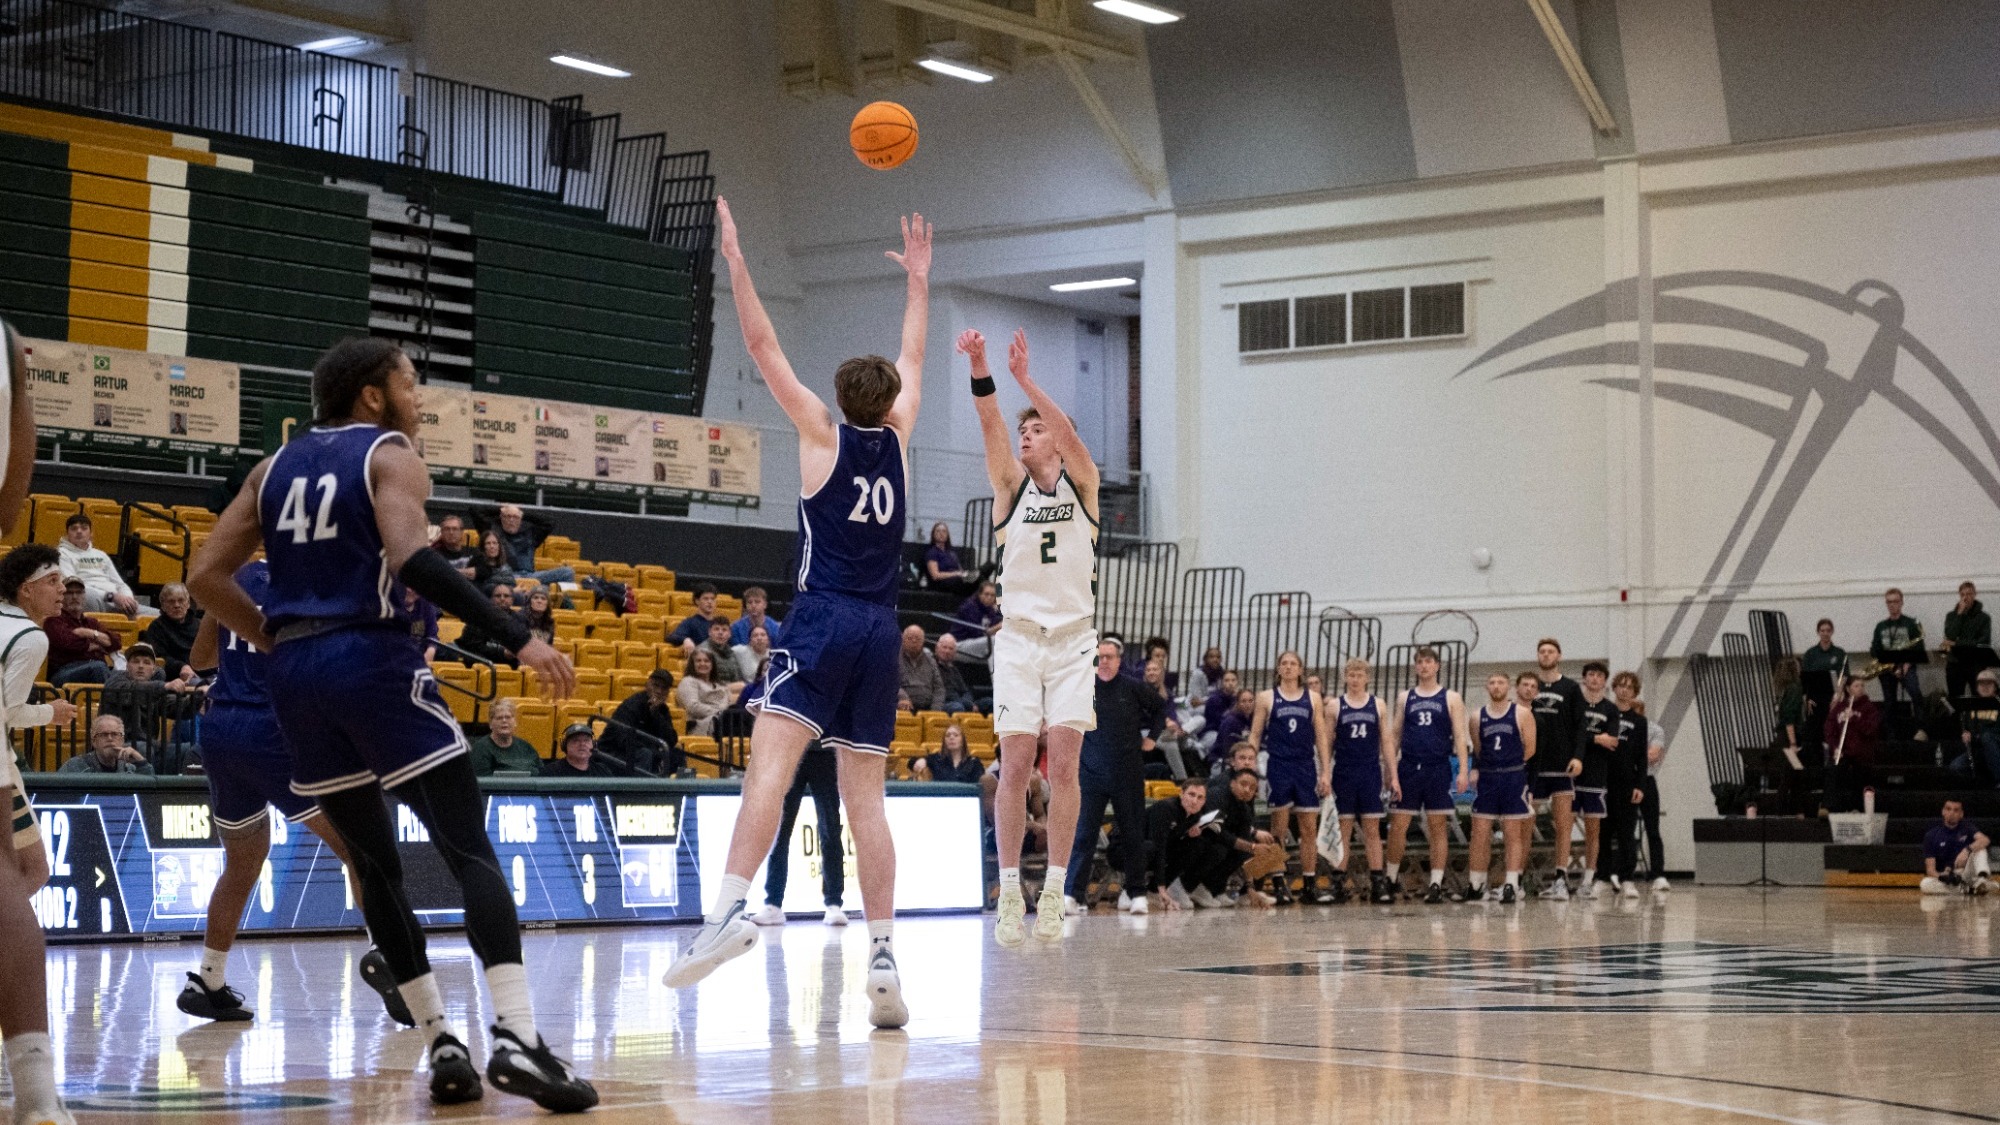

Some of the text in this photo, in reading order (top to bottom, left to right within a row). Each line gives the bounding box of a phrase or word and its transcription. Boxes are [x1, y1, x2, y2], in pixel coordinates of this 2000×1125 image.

[25, 367, 69, 385] ATHALIE
[94, 375, 128, 391] ARTUR
[169, 384, 205, 400] MARCO
[419, 412, 439, 425] CAR
[473, 418, 516, 434] NICHOLAS
[535, 425, 569, 440] GIORGIO
[595, 431, 629, 447] GABRIEL
[653, 437, 679, 451] GRACE
[276, 473, 338, 544] 42
[847, 476, 895, 525] 20
[1023, 505, 1073, 522] MINERS
[1041, 531, 1057, 564] 2
[1288, 718, 1298, 733] 9
[1417, 711, 1433, 726] 33
[1350, 723, 1368, 738] 24
[161, 804, 211, 839] MINERS
[498, 804, 537, 843] FOULS
[573, 804, 598, 843] TOL
[259, 859, 274, 913] 8
[512, 855, 527, 907] 9
[581, 853, 596, 905] 3
[66, 886, 78, 928] 2
